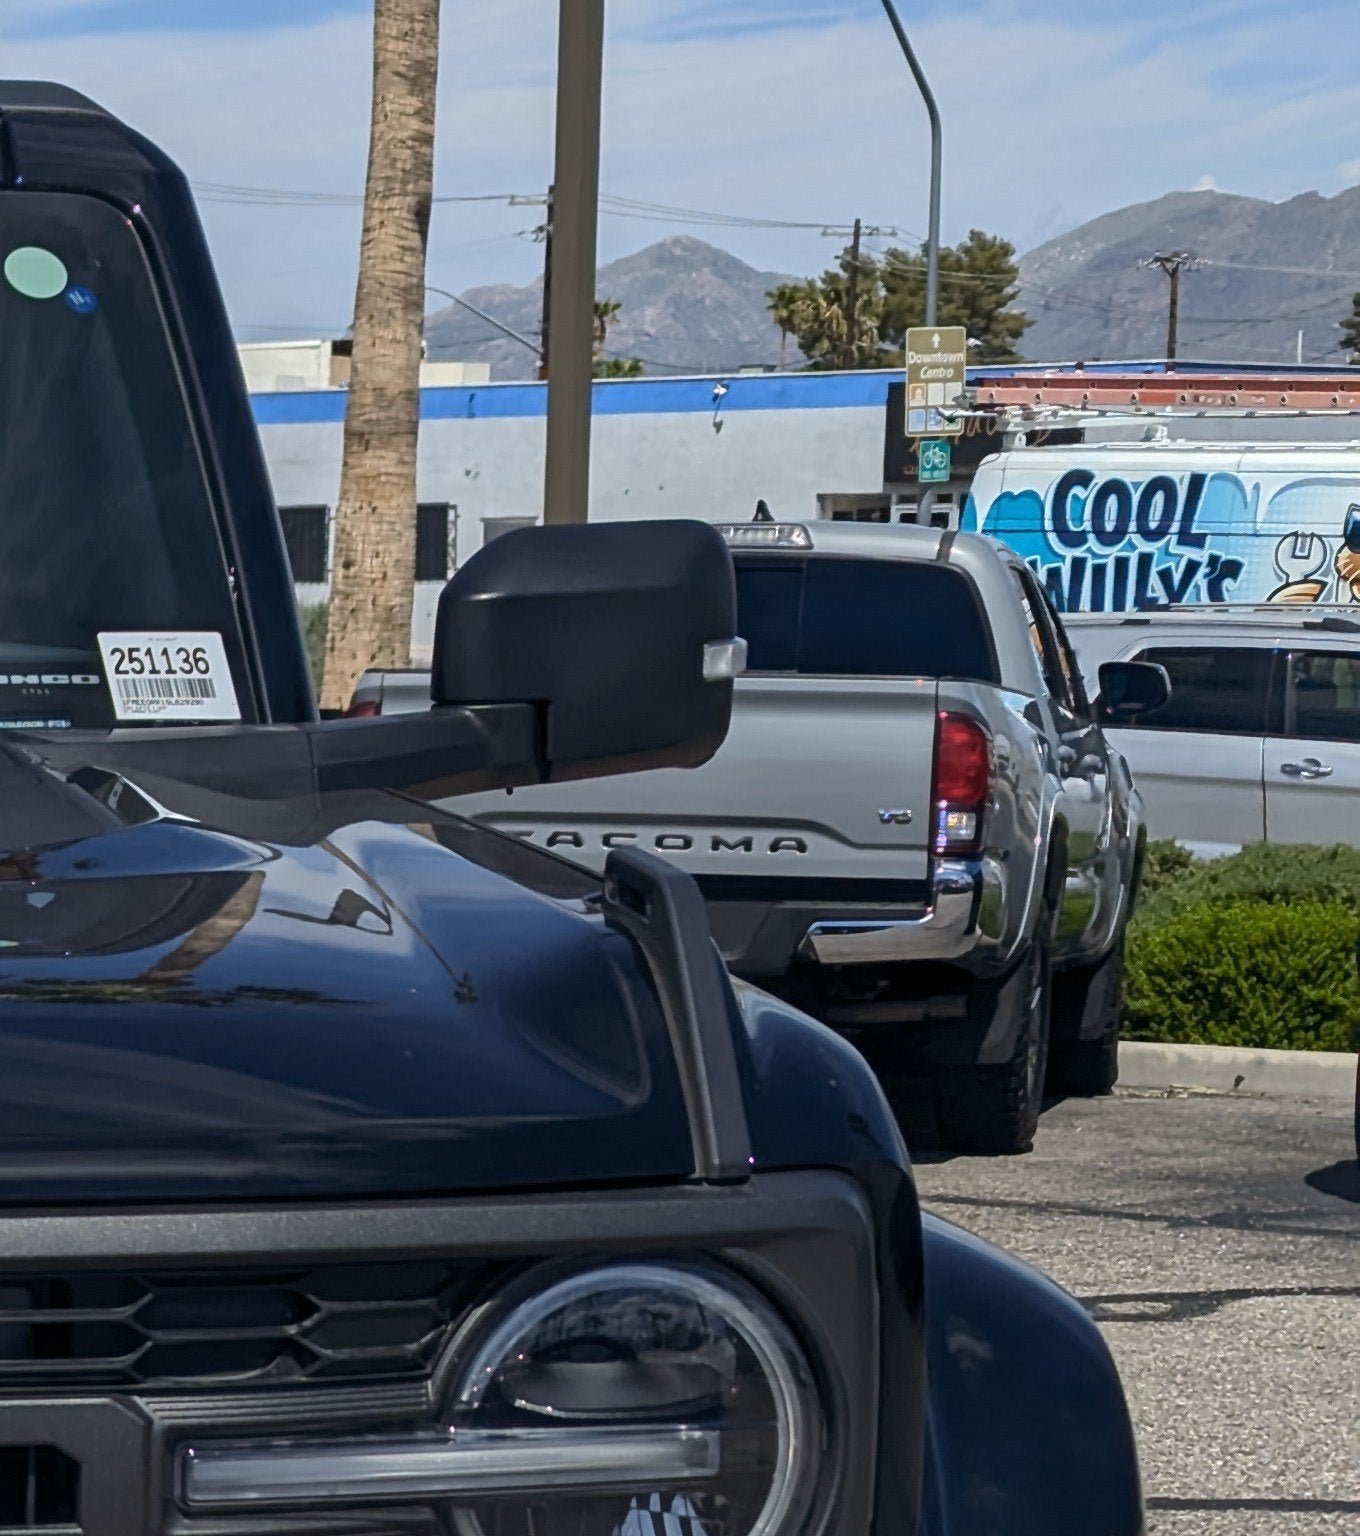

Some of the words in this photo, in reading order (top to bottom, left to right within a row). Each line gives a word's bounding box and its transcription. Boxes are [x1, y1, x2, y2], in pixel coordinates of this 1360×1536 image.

[908, 351, 964, 364] Downtown
[920, 366, 954, 379] Centro
[1050, 467, 1211, 549] COOL
[109, 646, 211, 675] 251136
